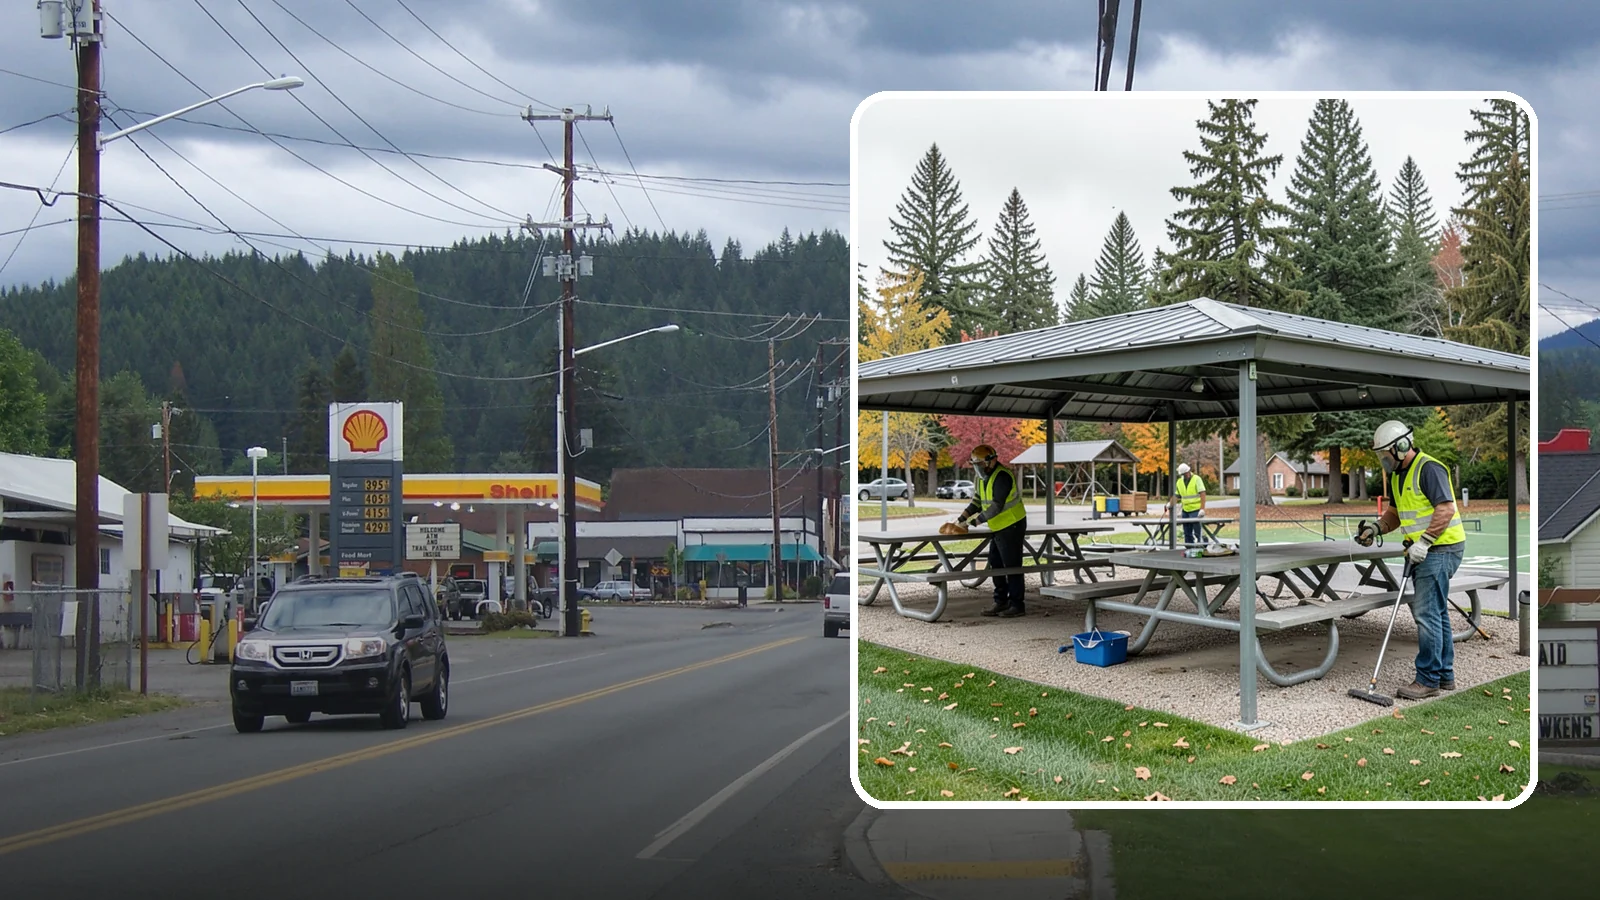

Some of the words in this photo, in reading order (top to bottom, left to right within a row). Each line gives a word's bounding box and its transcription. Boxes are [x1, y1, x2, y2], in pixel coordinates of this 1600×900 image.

[366, 480, 383, 490] 395
[490, 484, 547, 499] Shell
[366, 494, 383, 504] 405
[366, 508, 383, 518] 415
[366, 523, 383, 532] 429
